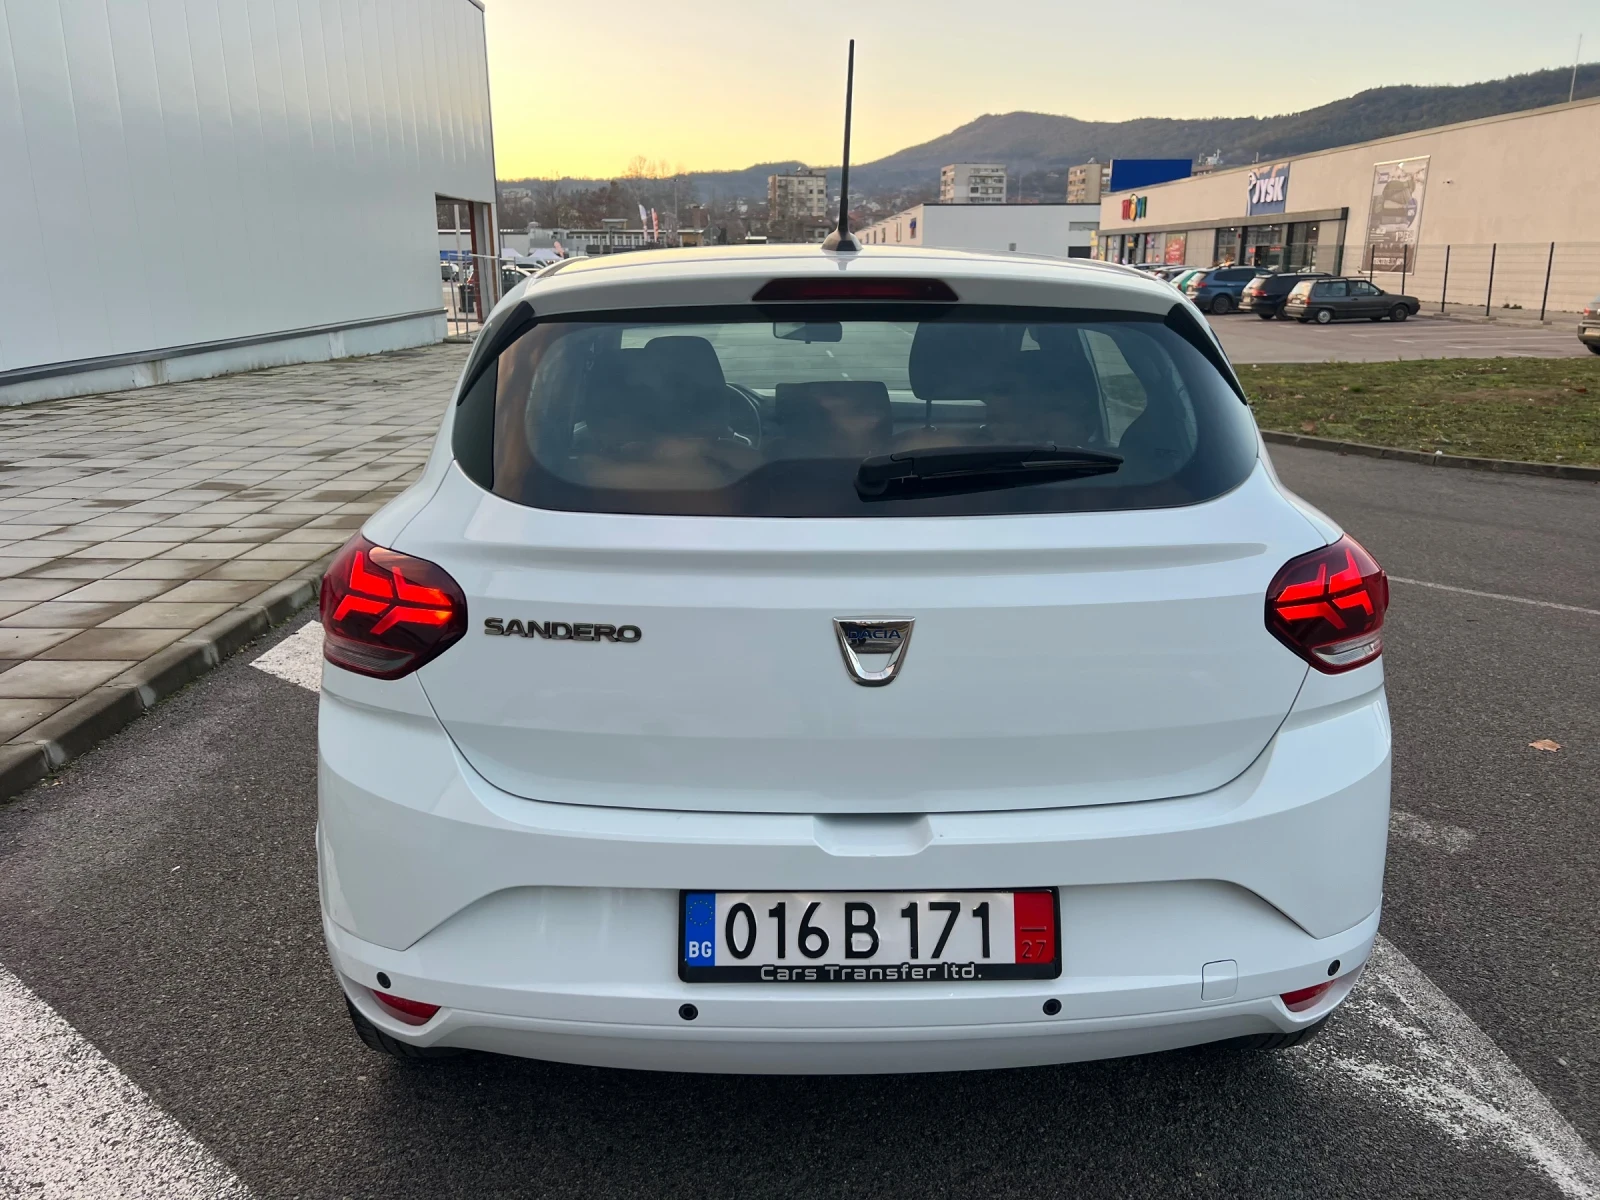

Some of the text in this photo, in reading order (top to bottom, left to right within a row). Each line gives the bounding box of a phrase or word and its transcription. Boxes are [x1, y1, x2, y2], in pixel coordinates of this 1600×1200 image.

[1252, 176, 1285, 203] JYSK
[484, 617, 642, 643] SANDERO
[848, 629, 901, 639] DACIA
[725, 901, 991, 960] 016 B 171
[688, 941, 712, 958] BG
[1021, 939, 1047, 959] 27
[760, 966, 817, 981] Cars
[825, 965, 936, 980] Transfer
